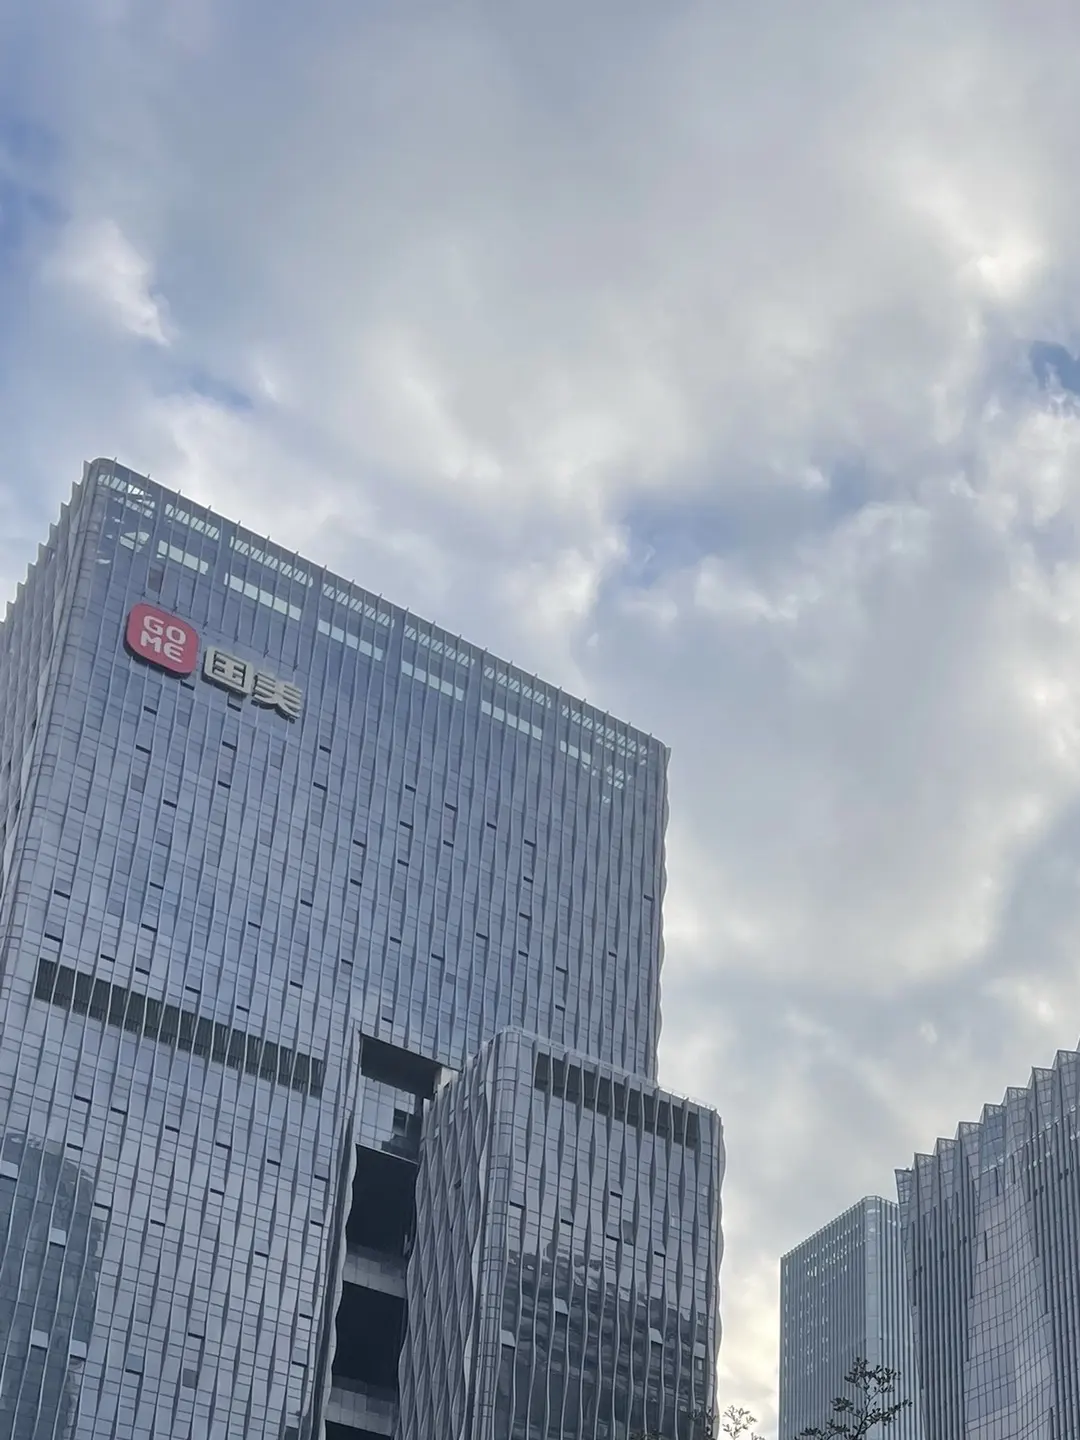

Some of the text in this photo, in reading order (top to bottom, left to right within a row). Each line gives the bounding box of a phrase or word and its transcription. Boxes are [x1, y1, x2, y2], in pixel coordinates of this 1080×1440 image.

[140, 630, 185, 664] ME
[143, 614, 187, 646] GO
[203, 646, 302, 721] 国美
